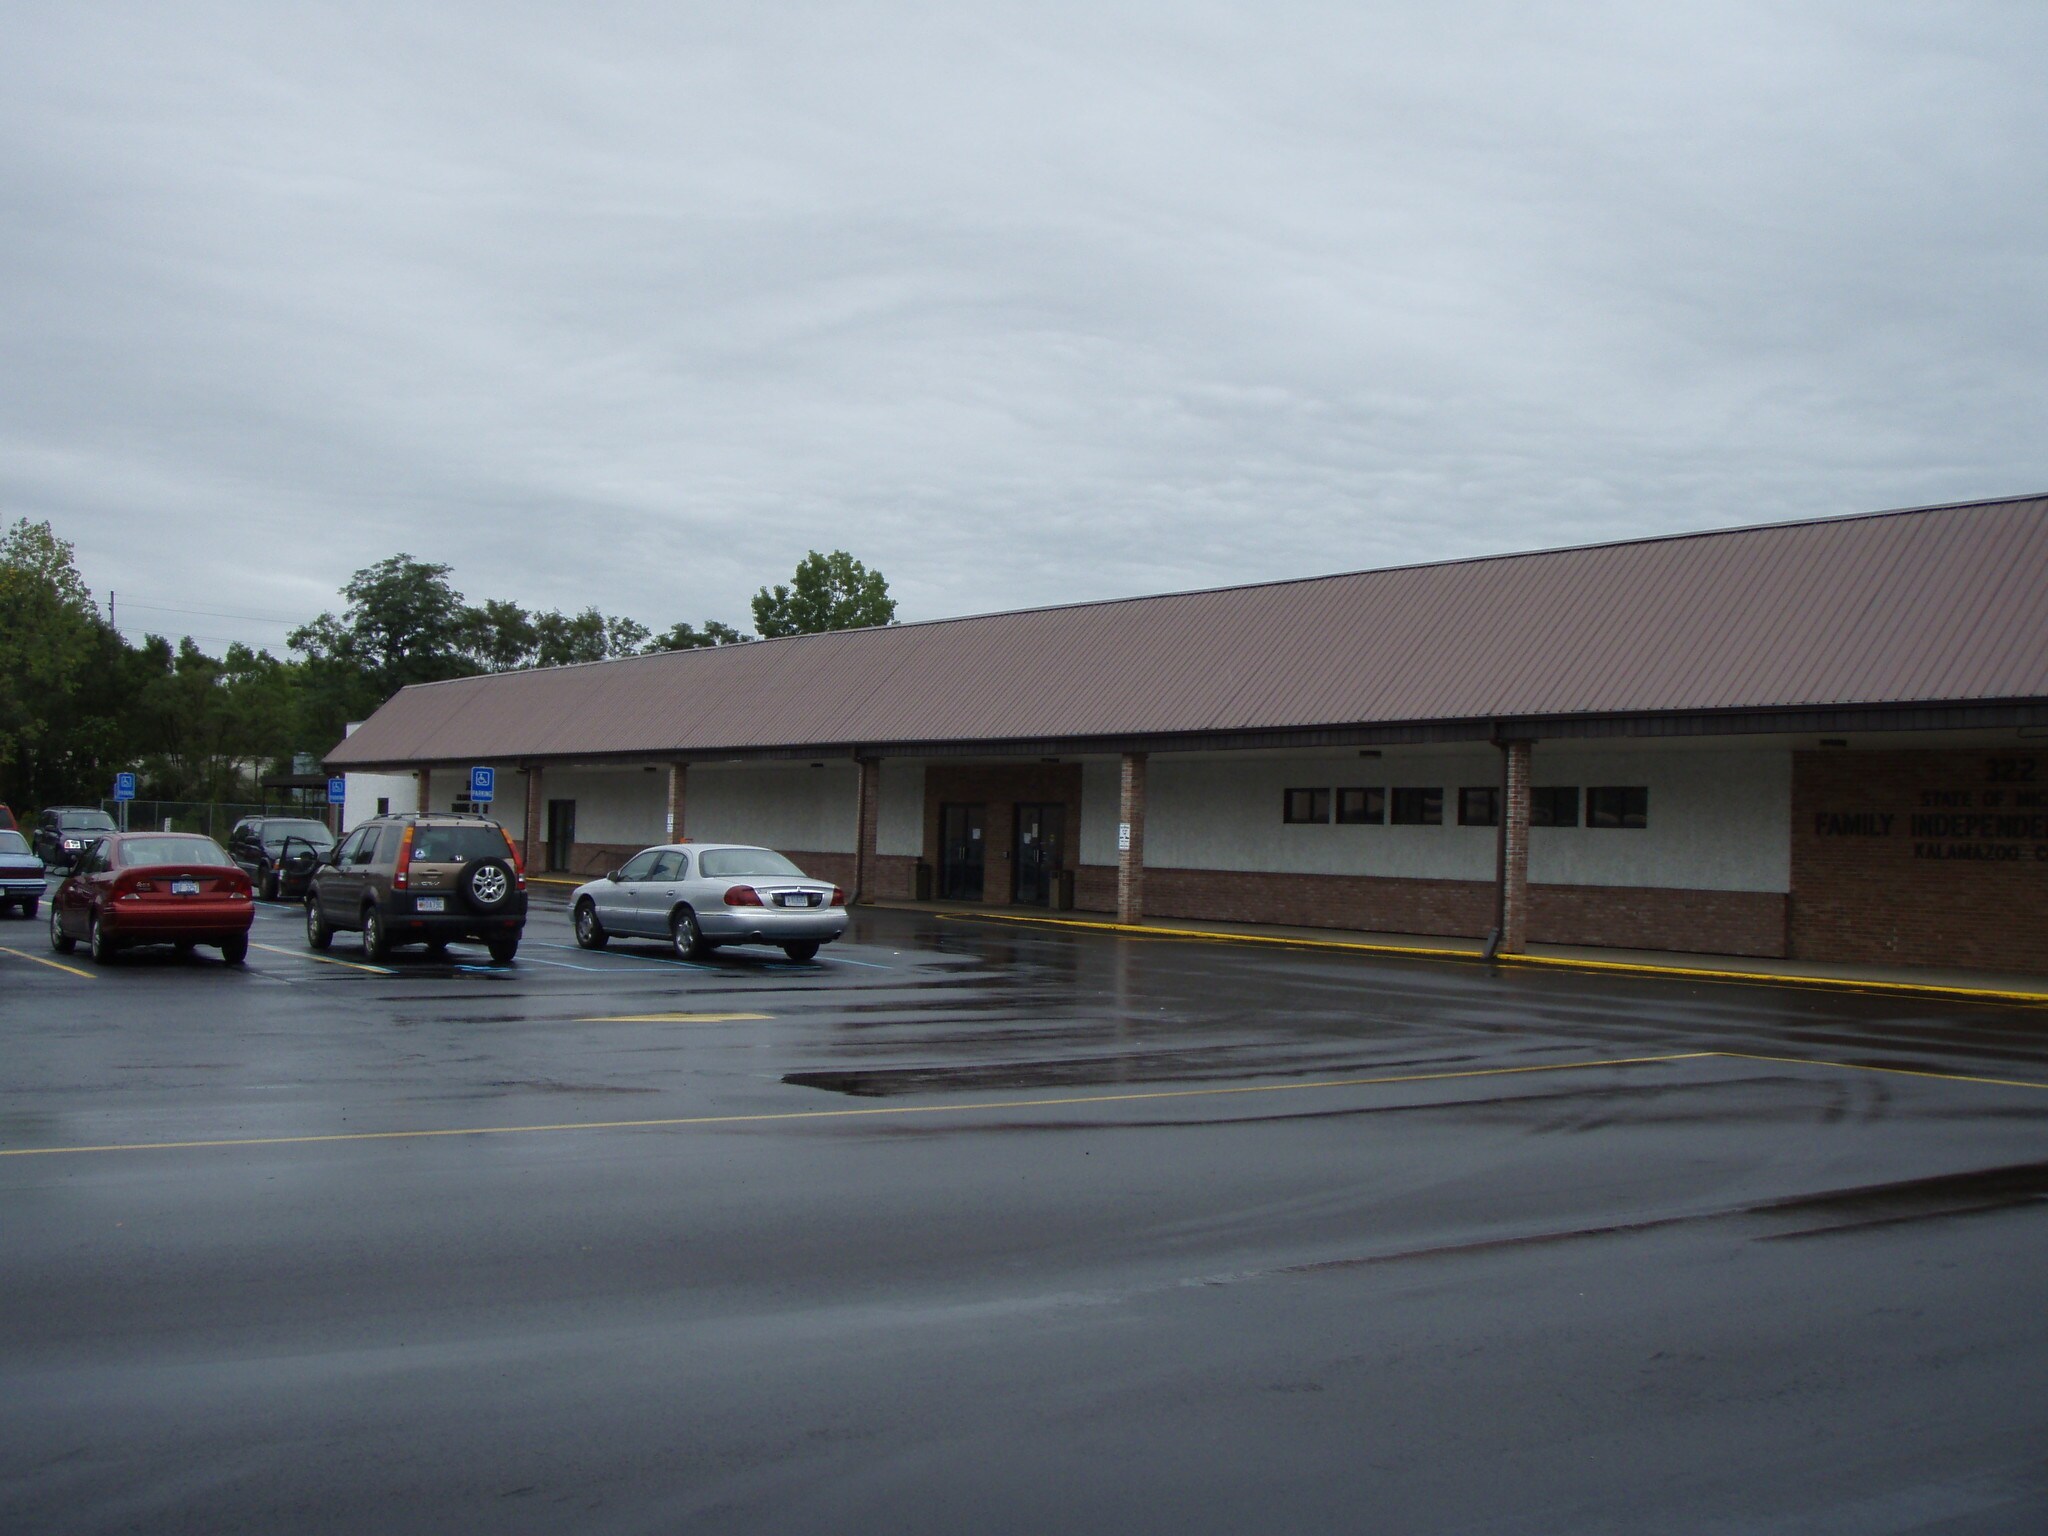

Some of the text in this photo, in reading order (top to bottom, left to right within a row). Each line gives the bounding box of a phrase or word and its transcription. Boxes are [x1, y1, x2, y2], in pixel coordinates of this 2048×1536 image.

[1922, 789, 1972, 806] STATE
[1983, 789, 2004, 806] OF
[1815, 813, 2048, 838] FAMILY INDEPENDE
[1915, 843, 2019, 861] KALAMAZOO
